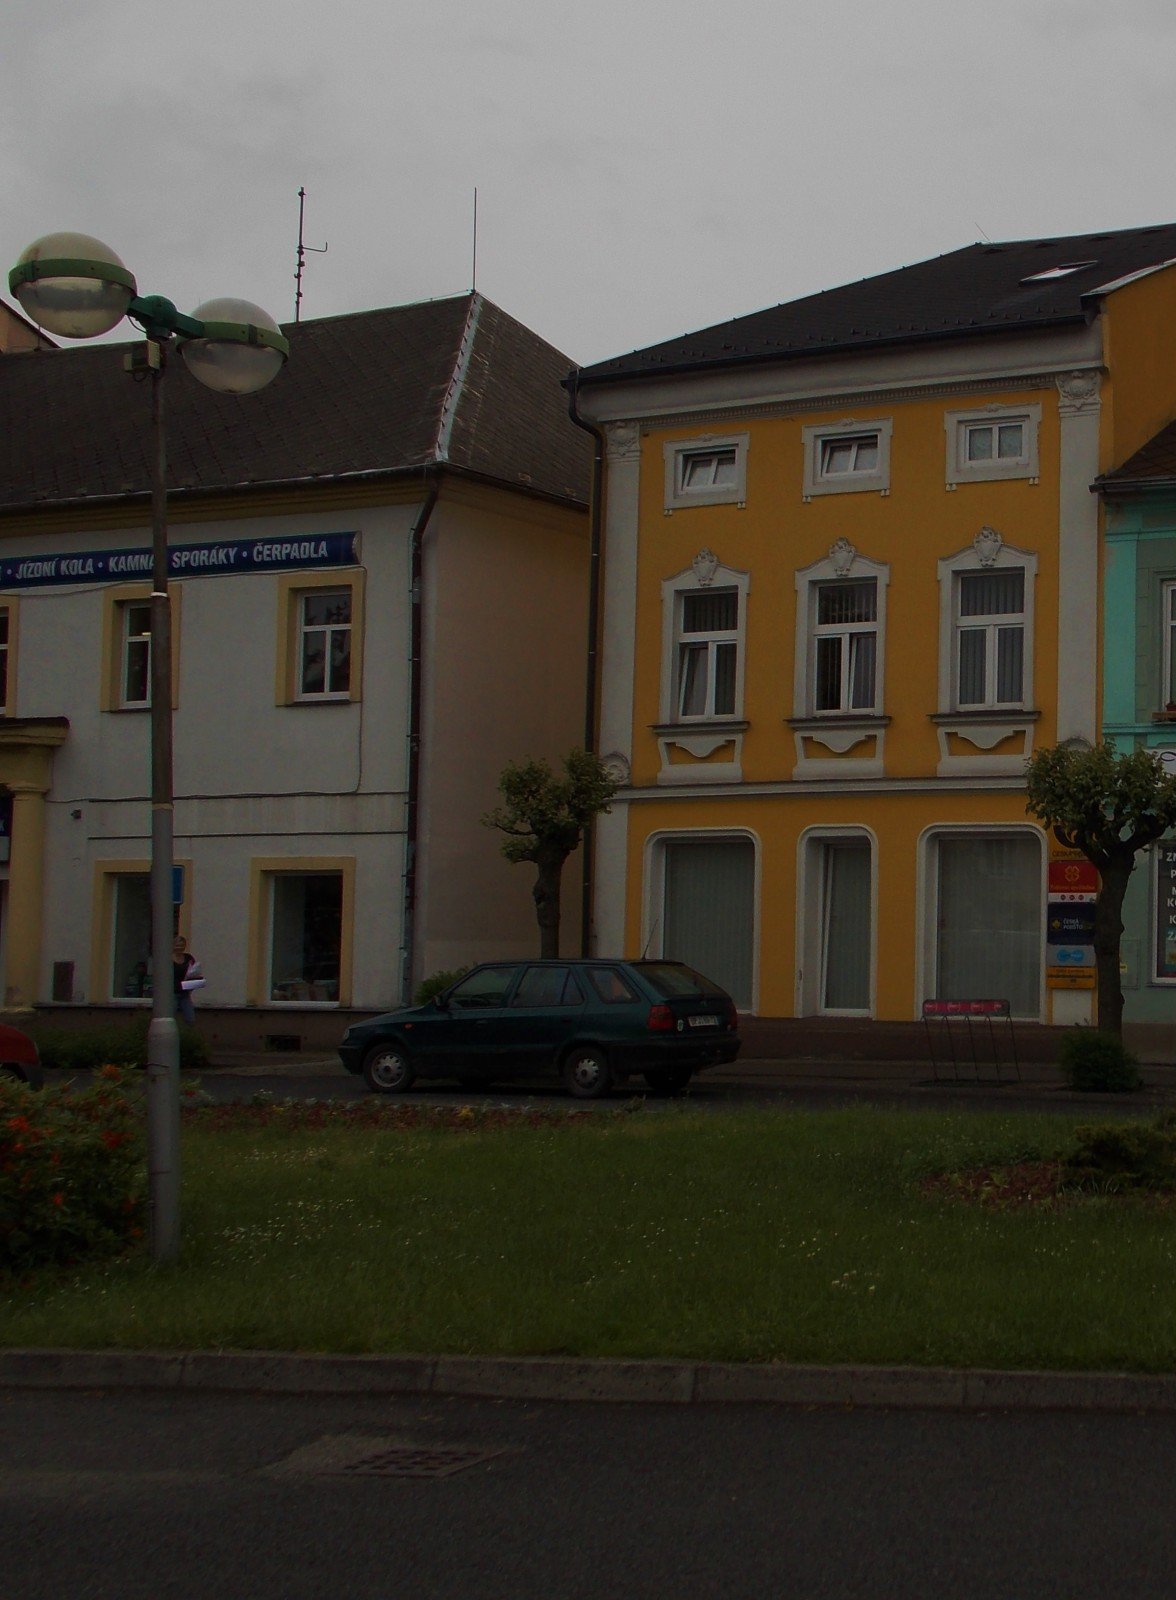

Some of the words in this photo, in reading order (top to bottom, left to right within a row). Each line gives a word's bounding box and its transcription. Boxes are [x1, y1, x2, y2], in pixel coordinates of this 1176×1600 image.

[16, 558, 60, 579] JÍZDNÍ
[60, 558, 94, 576] KOLA
[172, 545, 239, 569] SPORÁKY
[253, 540, 328, 563] ČERPADLA
